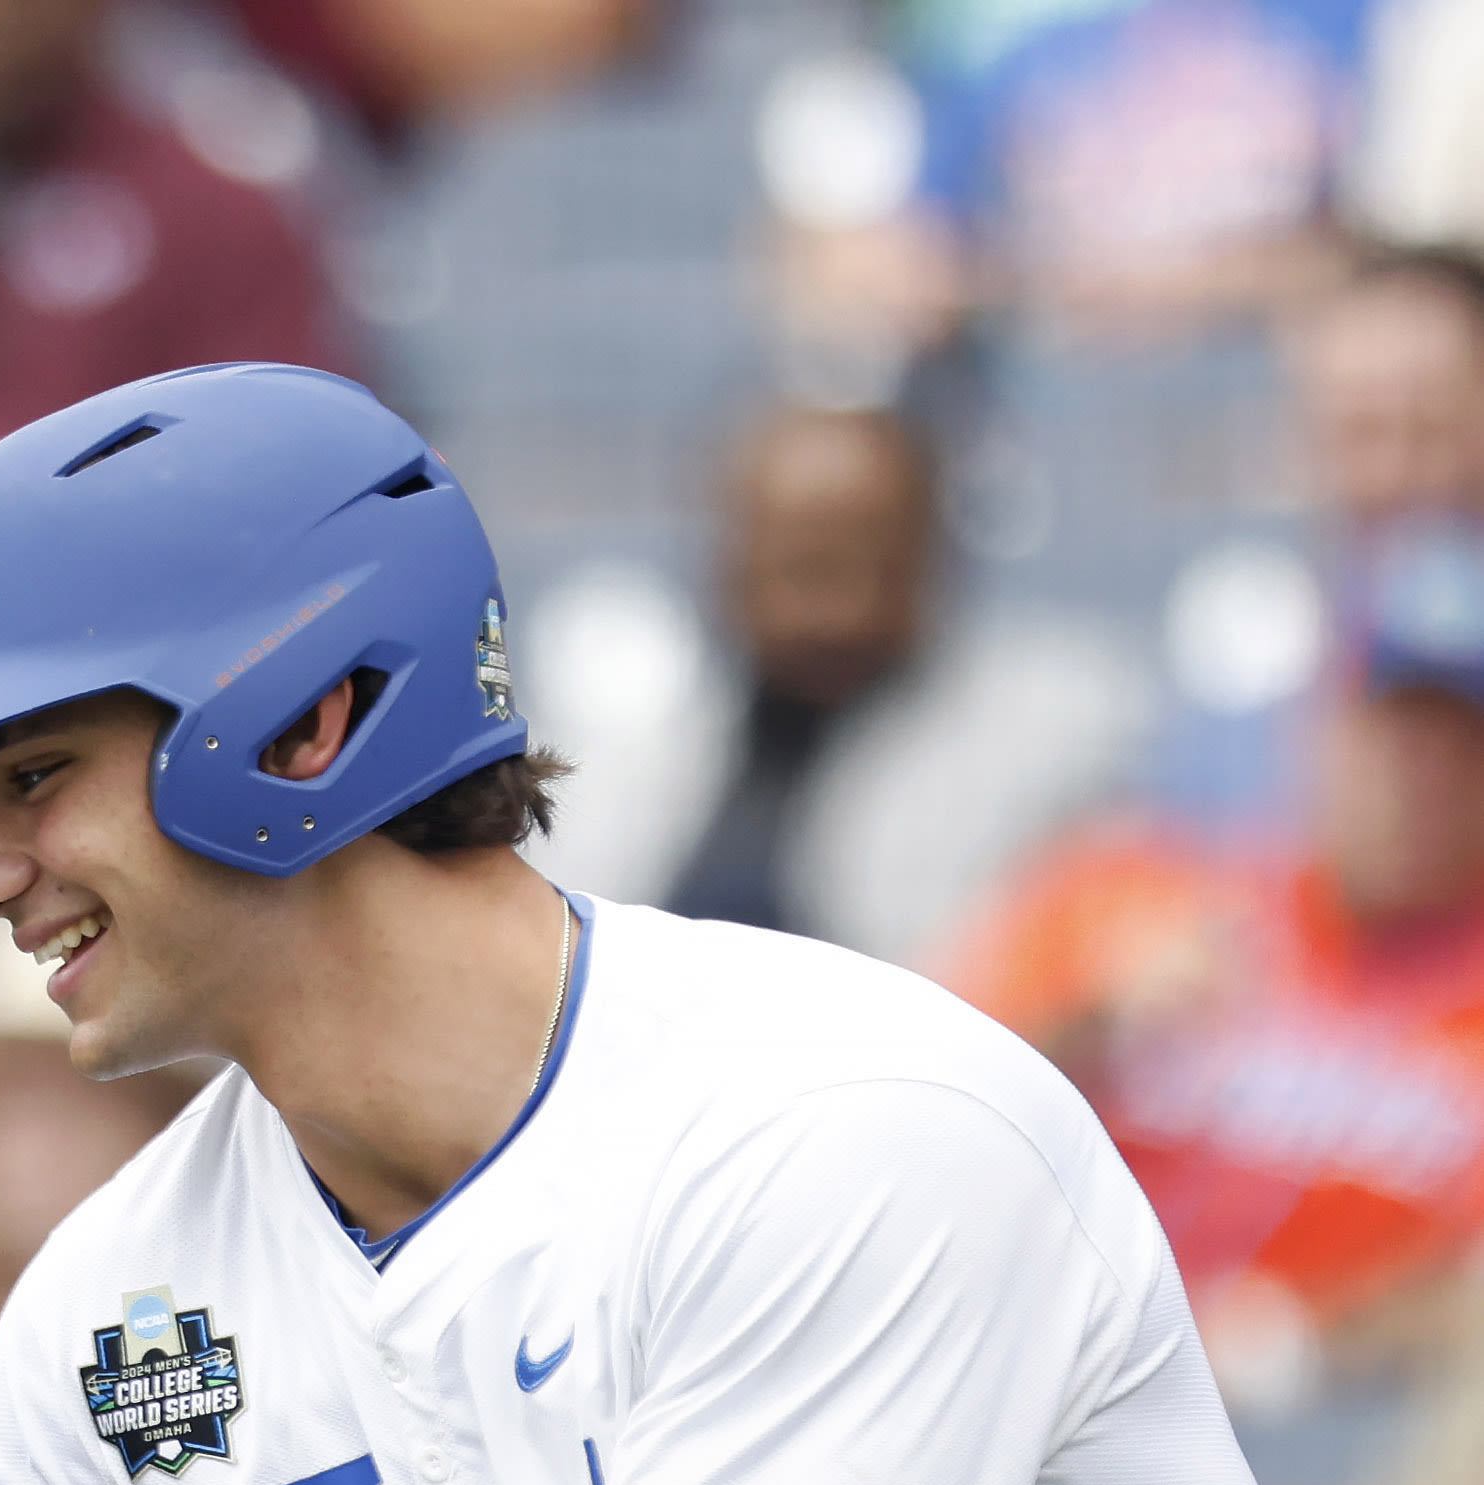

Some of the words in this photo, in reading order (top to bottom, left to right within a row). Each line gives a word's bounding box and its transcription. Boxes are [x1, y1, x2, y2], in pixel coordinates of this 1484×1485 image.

[133, 1312, 169, 1331] NCAA
[121, 1364, 151, 1380] 2024
[155, 1356, 192, 1371] MEN'S
[113, 1366, 204, 1408] COLLEGE
[96, 1407, 161, 1438] WORLD
[165, 1385, 238, 1423] SERIES
[144, 1422, 192, 1443] OMAHA
